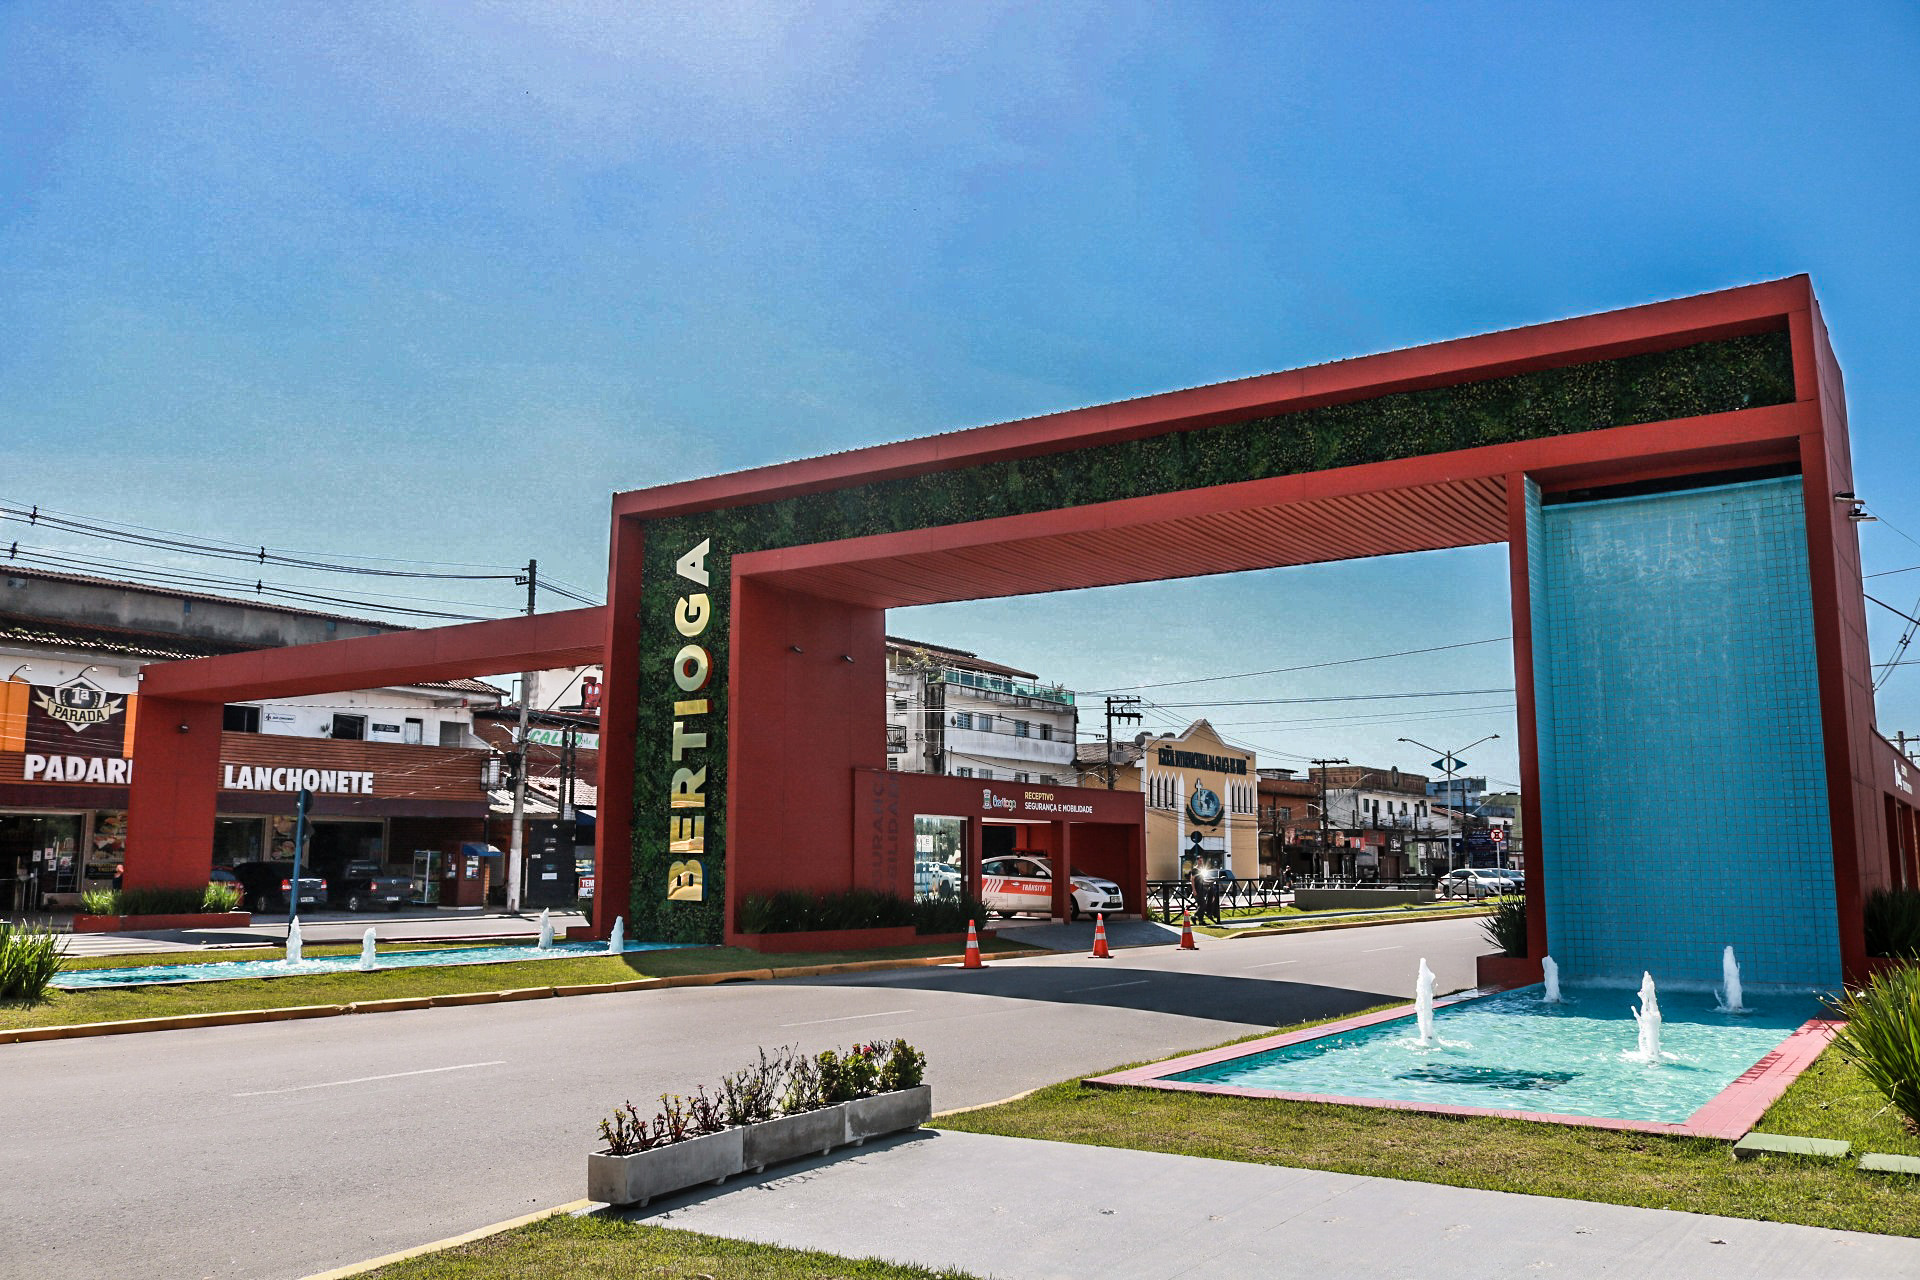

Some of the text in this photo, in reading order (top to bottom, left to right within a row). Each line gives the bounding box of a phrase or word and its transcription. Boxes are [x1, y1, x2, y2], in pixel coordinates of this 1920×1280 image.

[52, 705, 106, 722] PARADA
[667, 538, 711, 902] BERTIOGA
[223, 764, 374, 794] LANCHONETE
[1024, 791, 1054, 801] RECEPTIVO
[1024, 801, 1093, 814] SEGURANÇA E MOBILIDADE
